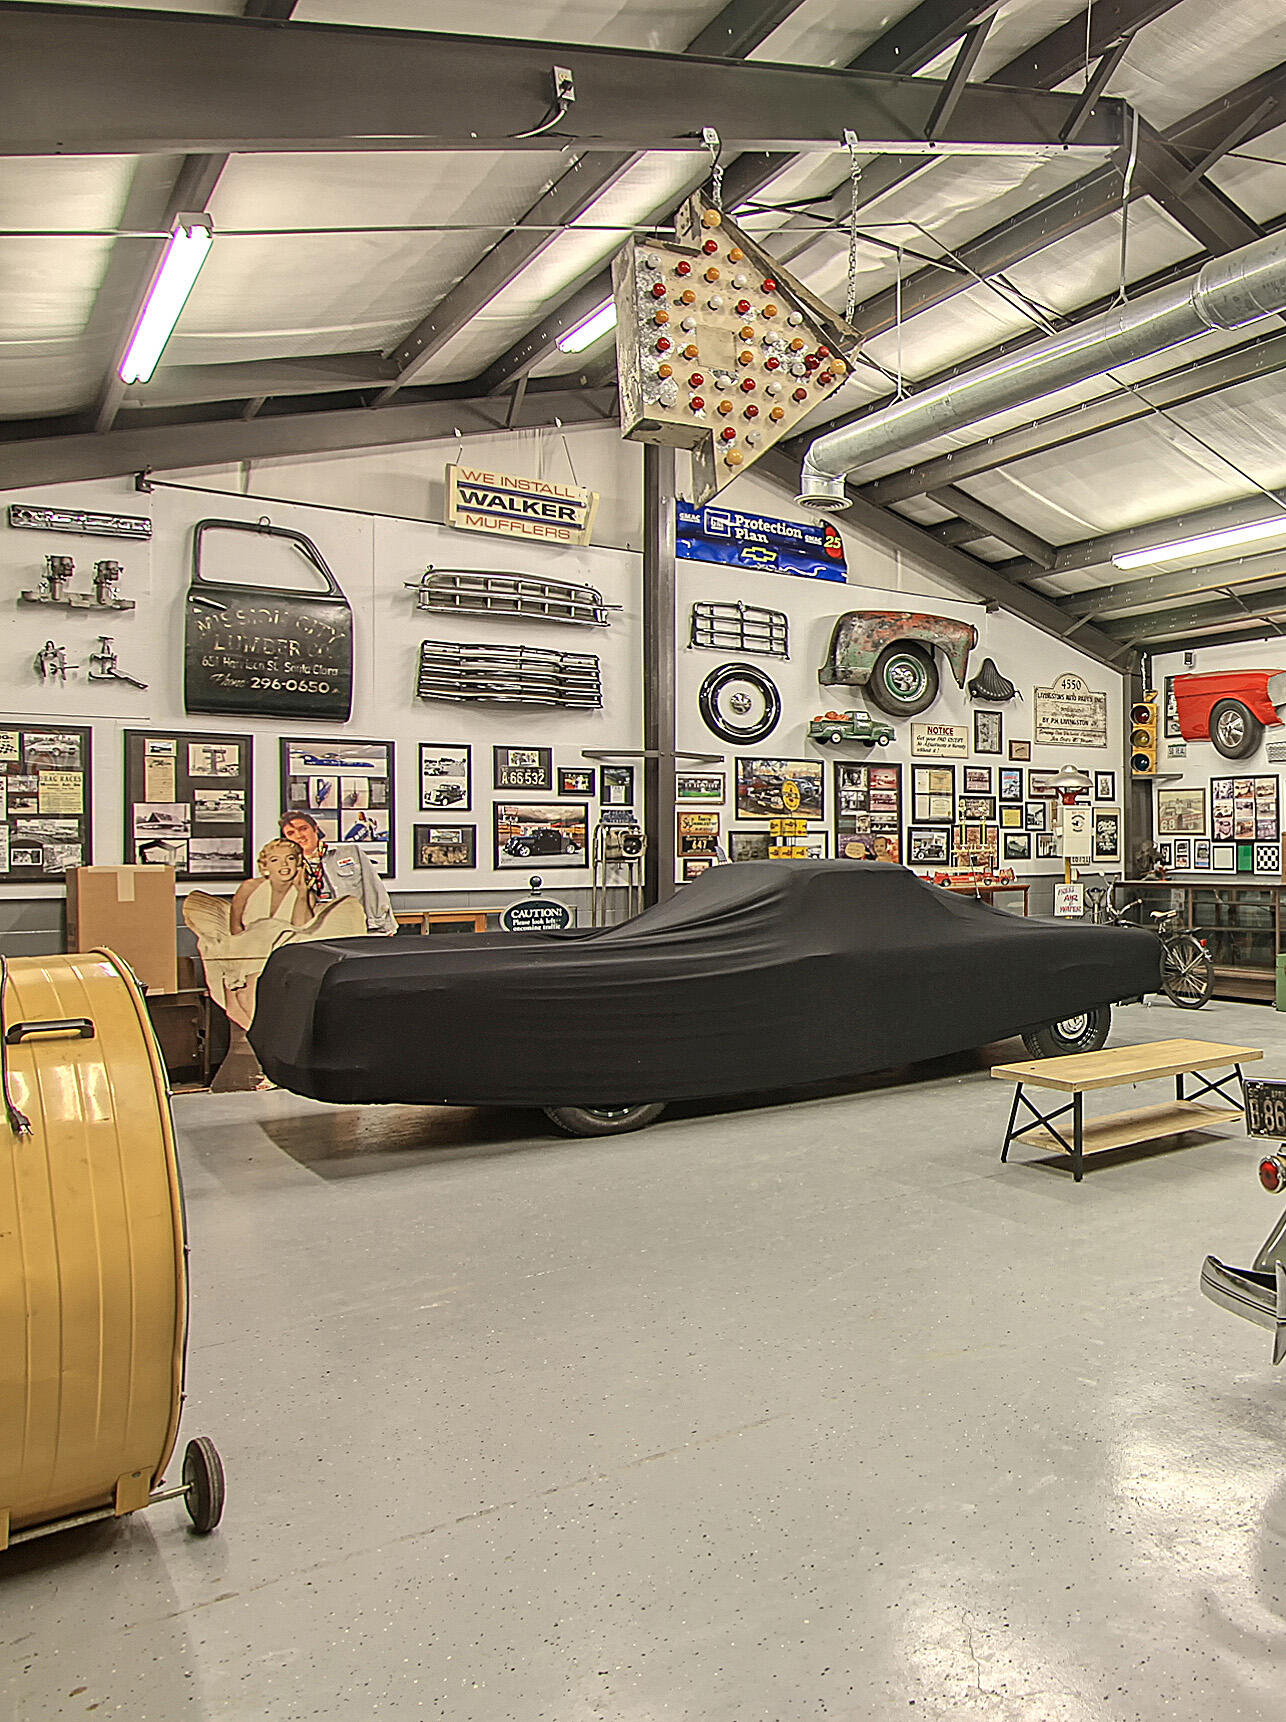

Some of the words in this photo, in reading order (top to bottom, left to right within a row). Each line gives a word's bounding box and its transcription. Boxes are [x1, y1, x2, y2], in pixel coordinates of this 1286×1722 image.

[461, 469, 495, 485] WE
[501, 476, 575, 498] INSTALL
[459, 489, 577, 522] WALKER
[679, 512, 701, 521] GMAC
[466, 514, 571, 540] MUFFLERS
[734, 514, 803, 540] Protection
[734, 528, 769, 544] Plan
[824, 535, 842, 549] 25
[250, 677, 330, 694] 296-0650
[1061, 679, 1082, 690] 4550
[927, 726, 954, 736] NOTICE
[691, 840, 707, 850] 647
[511, 908, 563, 919] CAUTION!
